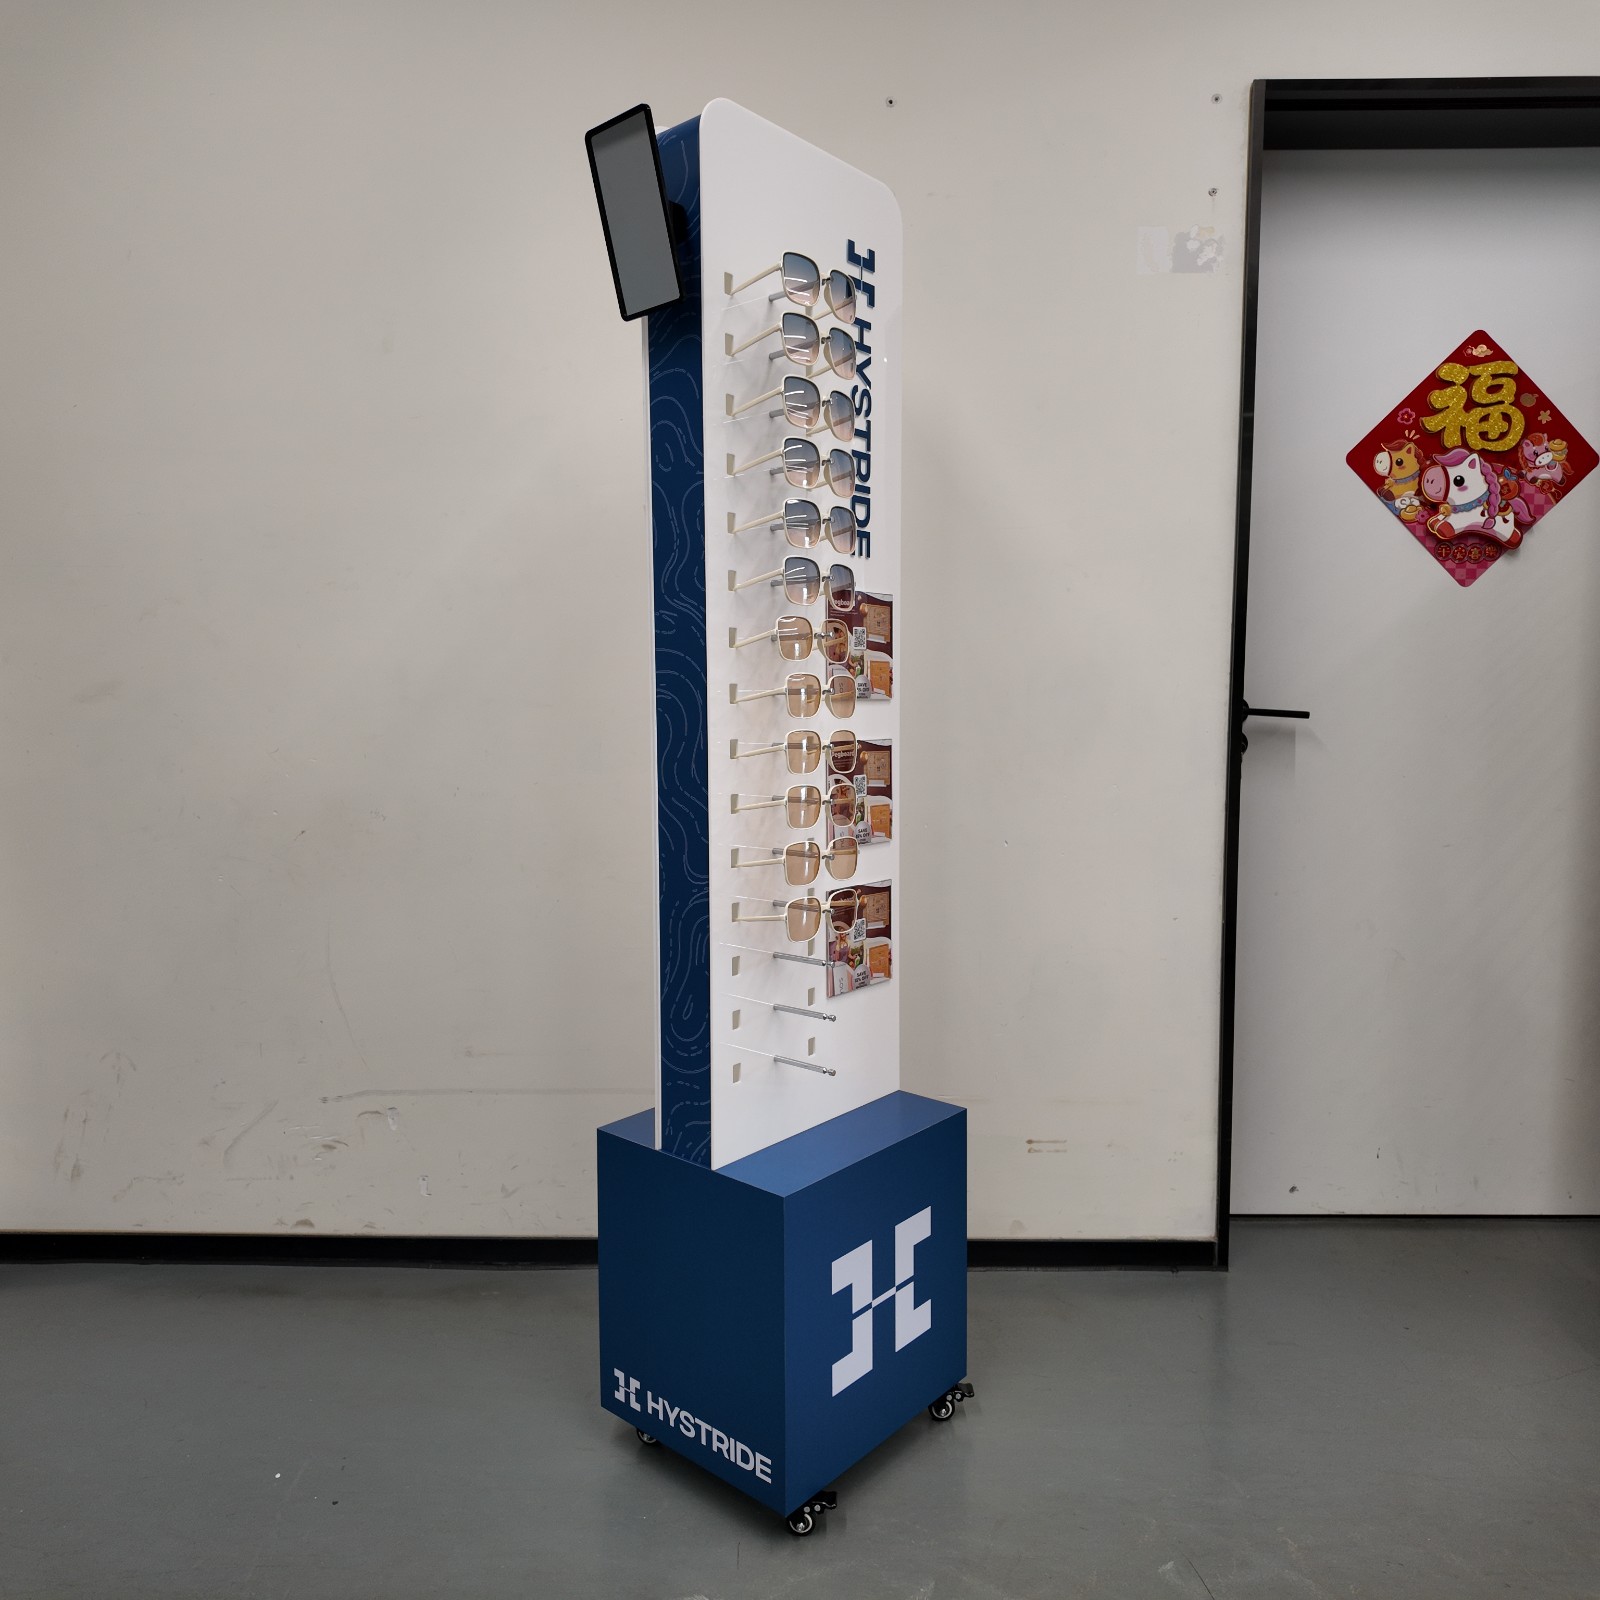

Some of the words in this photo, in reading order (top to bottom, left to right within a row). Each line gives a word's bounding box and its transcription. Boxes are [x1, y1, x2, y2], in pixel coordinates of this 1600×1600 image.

[851, 317, 872, 559] HYSTRIDE
[1419, 360, 1525, 452] 福
[646, 1390, 772, 1484] HYSTRIDE
